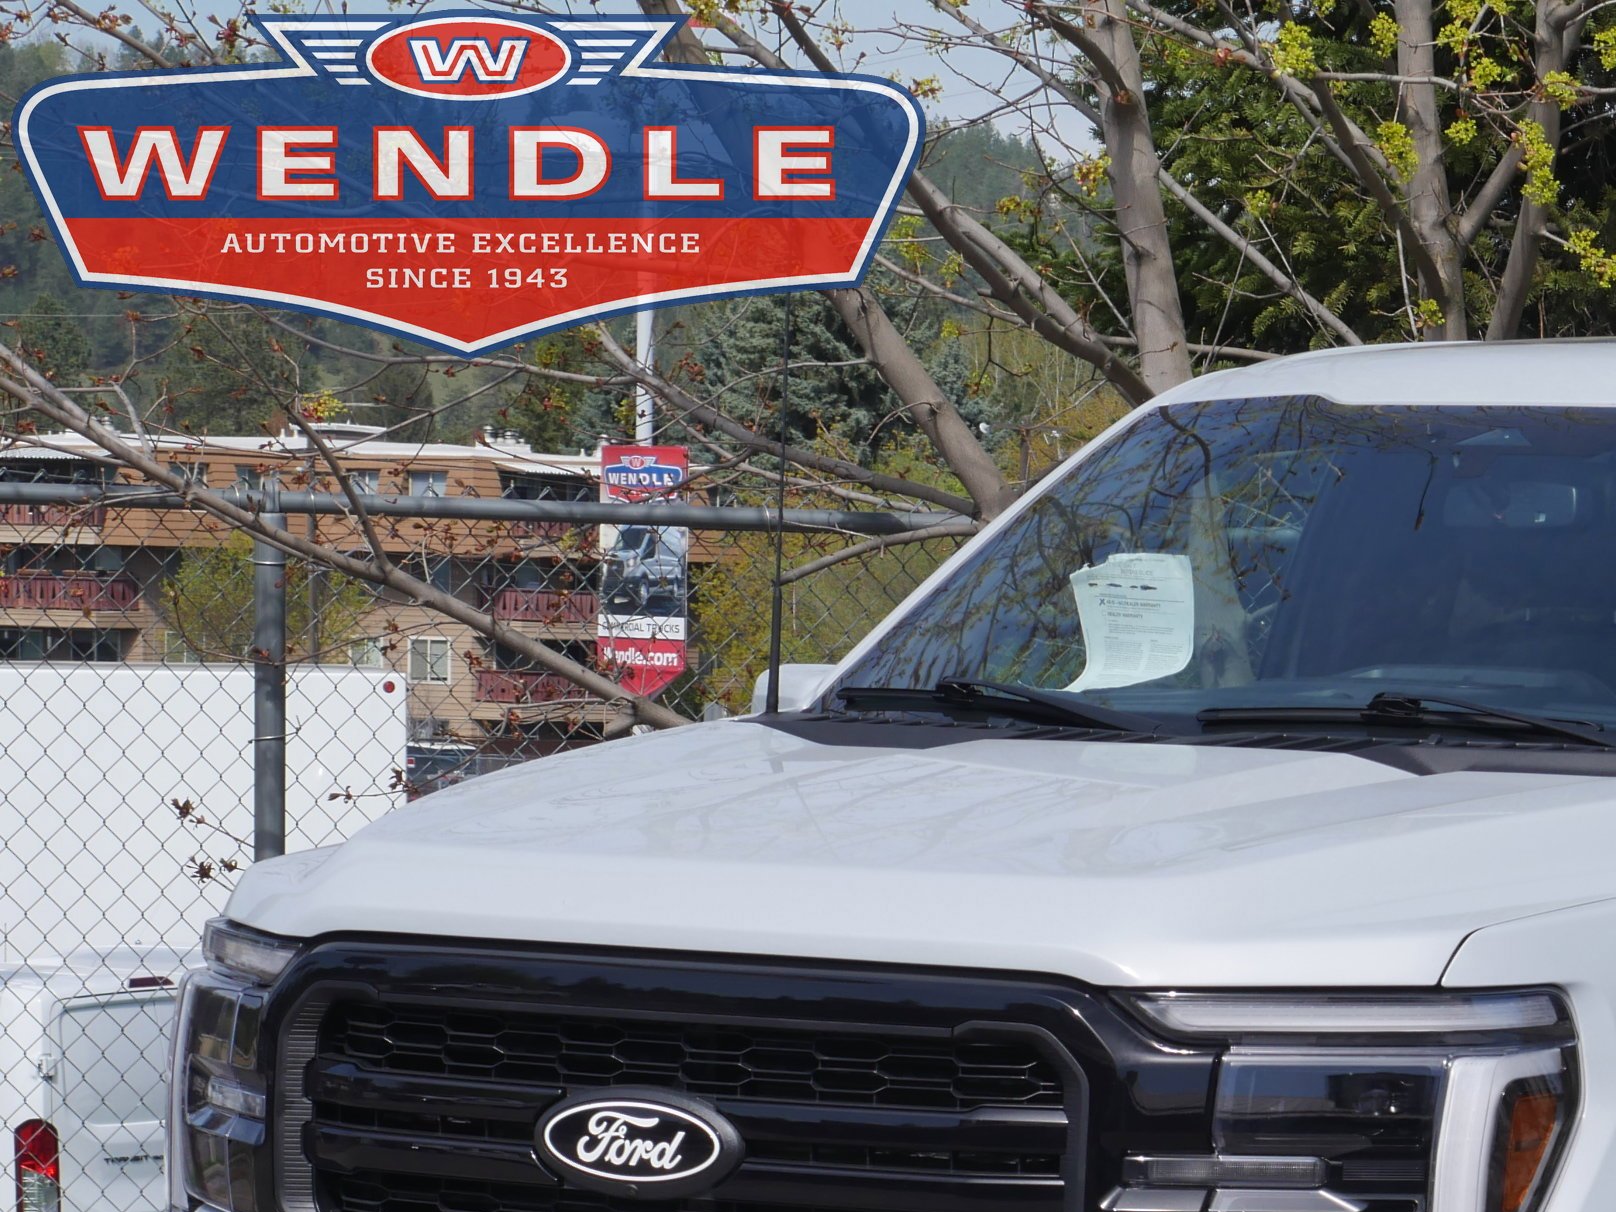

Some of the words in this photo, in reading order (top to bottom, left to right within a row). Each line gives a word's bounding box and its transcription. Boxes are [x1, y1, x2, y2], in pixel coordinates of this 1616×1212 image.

[608, 472, 674, 486] WENDLE
[603, 646, 678, 666] Wndle.com
[577, 1111, 686, 1170] Ford
